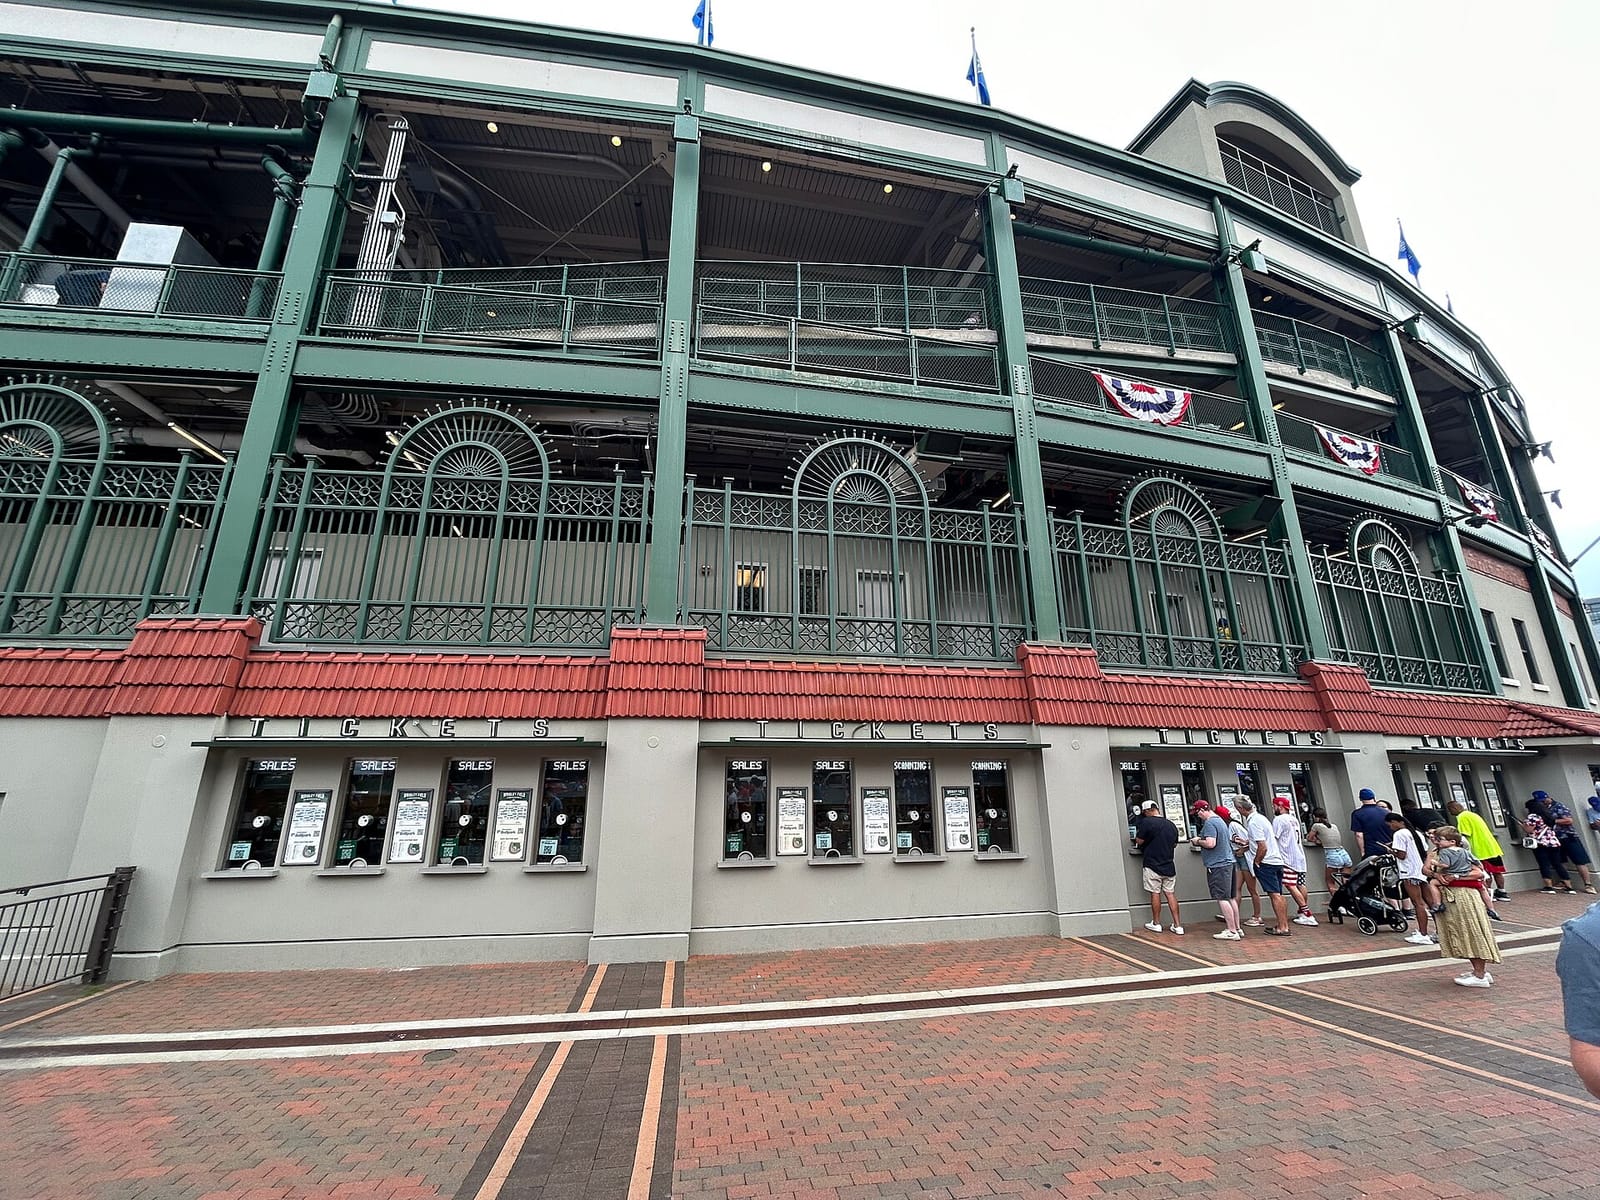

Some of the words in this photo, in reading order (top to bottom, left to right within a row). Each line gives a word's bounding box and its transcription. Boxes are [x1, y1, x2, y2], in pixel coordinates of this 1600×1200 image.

[250, 718, 549, 737] TICKETS
[756, 720, 999, 740] TICKETS
[1159, 728, 1324, 745] TICKETS
[1423, 734, 1525, 750] TICKETS
[259, 760, 297, 771] SALES
[360, 760, 396, 771] SALES
[458, 761, 492, 771] SALES
[552, 761, 586, 771] SALES
[731, 761, 763, 770] SALES
[815, 761, 845, 770] SALES
[893, 761, 927, 771] SCANNING
